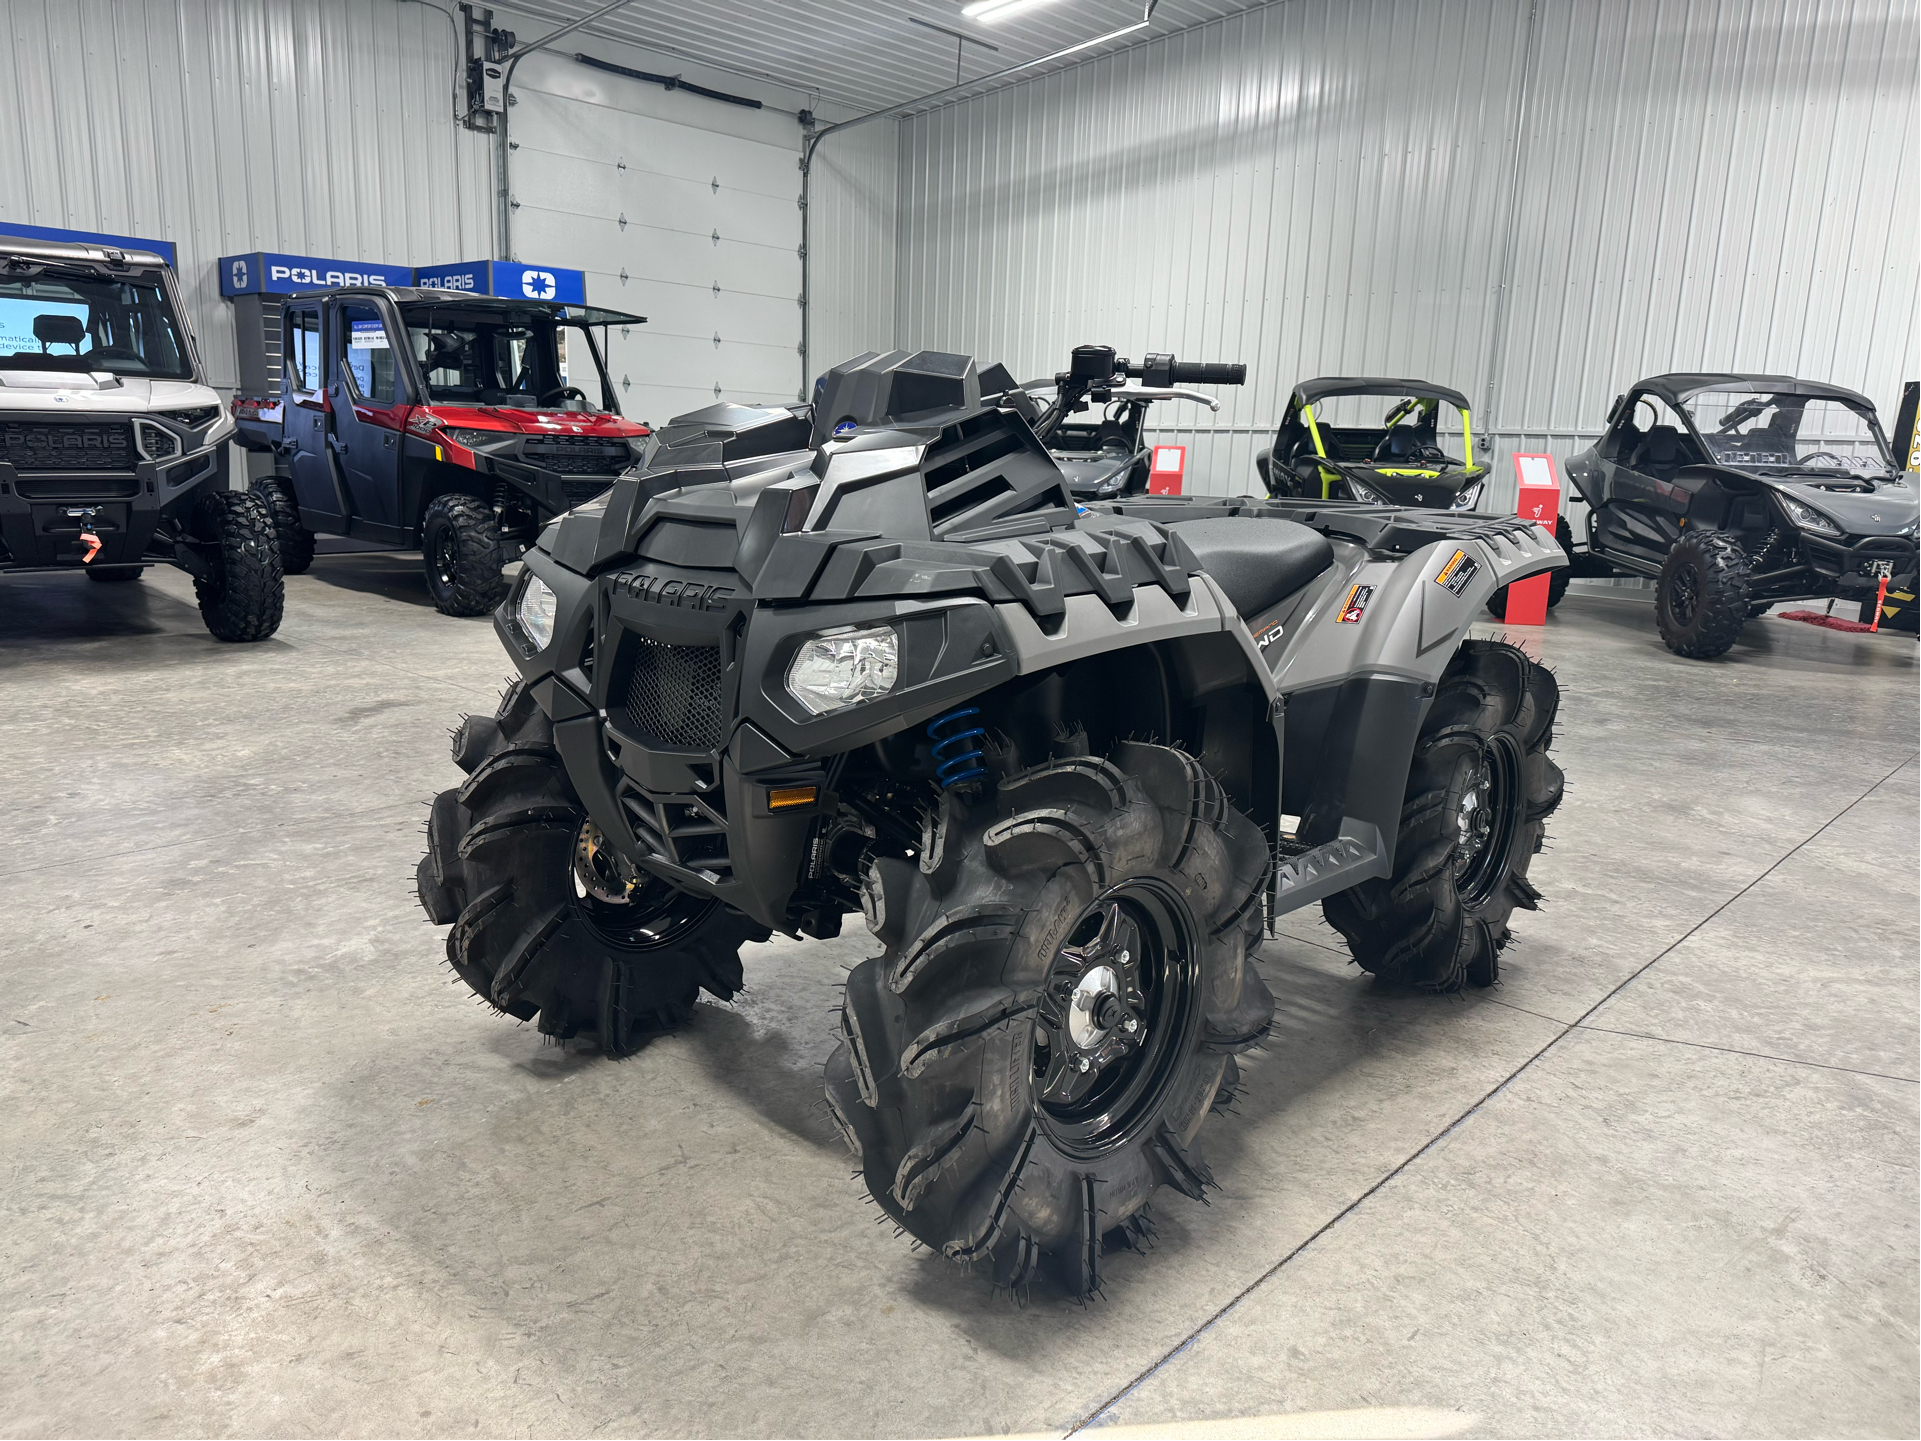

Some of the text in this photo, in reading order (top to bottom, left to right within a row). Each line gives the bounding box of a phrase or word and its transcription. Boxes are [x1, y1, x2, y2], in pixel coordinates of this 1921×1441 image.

[271, 266, 386, 287] POLARIS
[420, 274, 474, 290] POLARIS
[4, 434, 127, 448] POLARIS
[555, 446, 604, 455] POLARIS
[612, 571, 736, 613] POLARIS
[1257, 625, 1284, 649] WD
[808, 837, 819, 879] POLARIS
